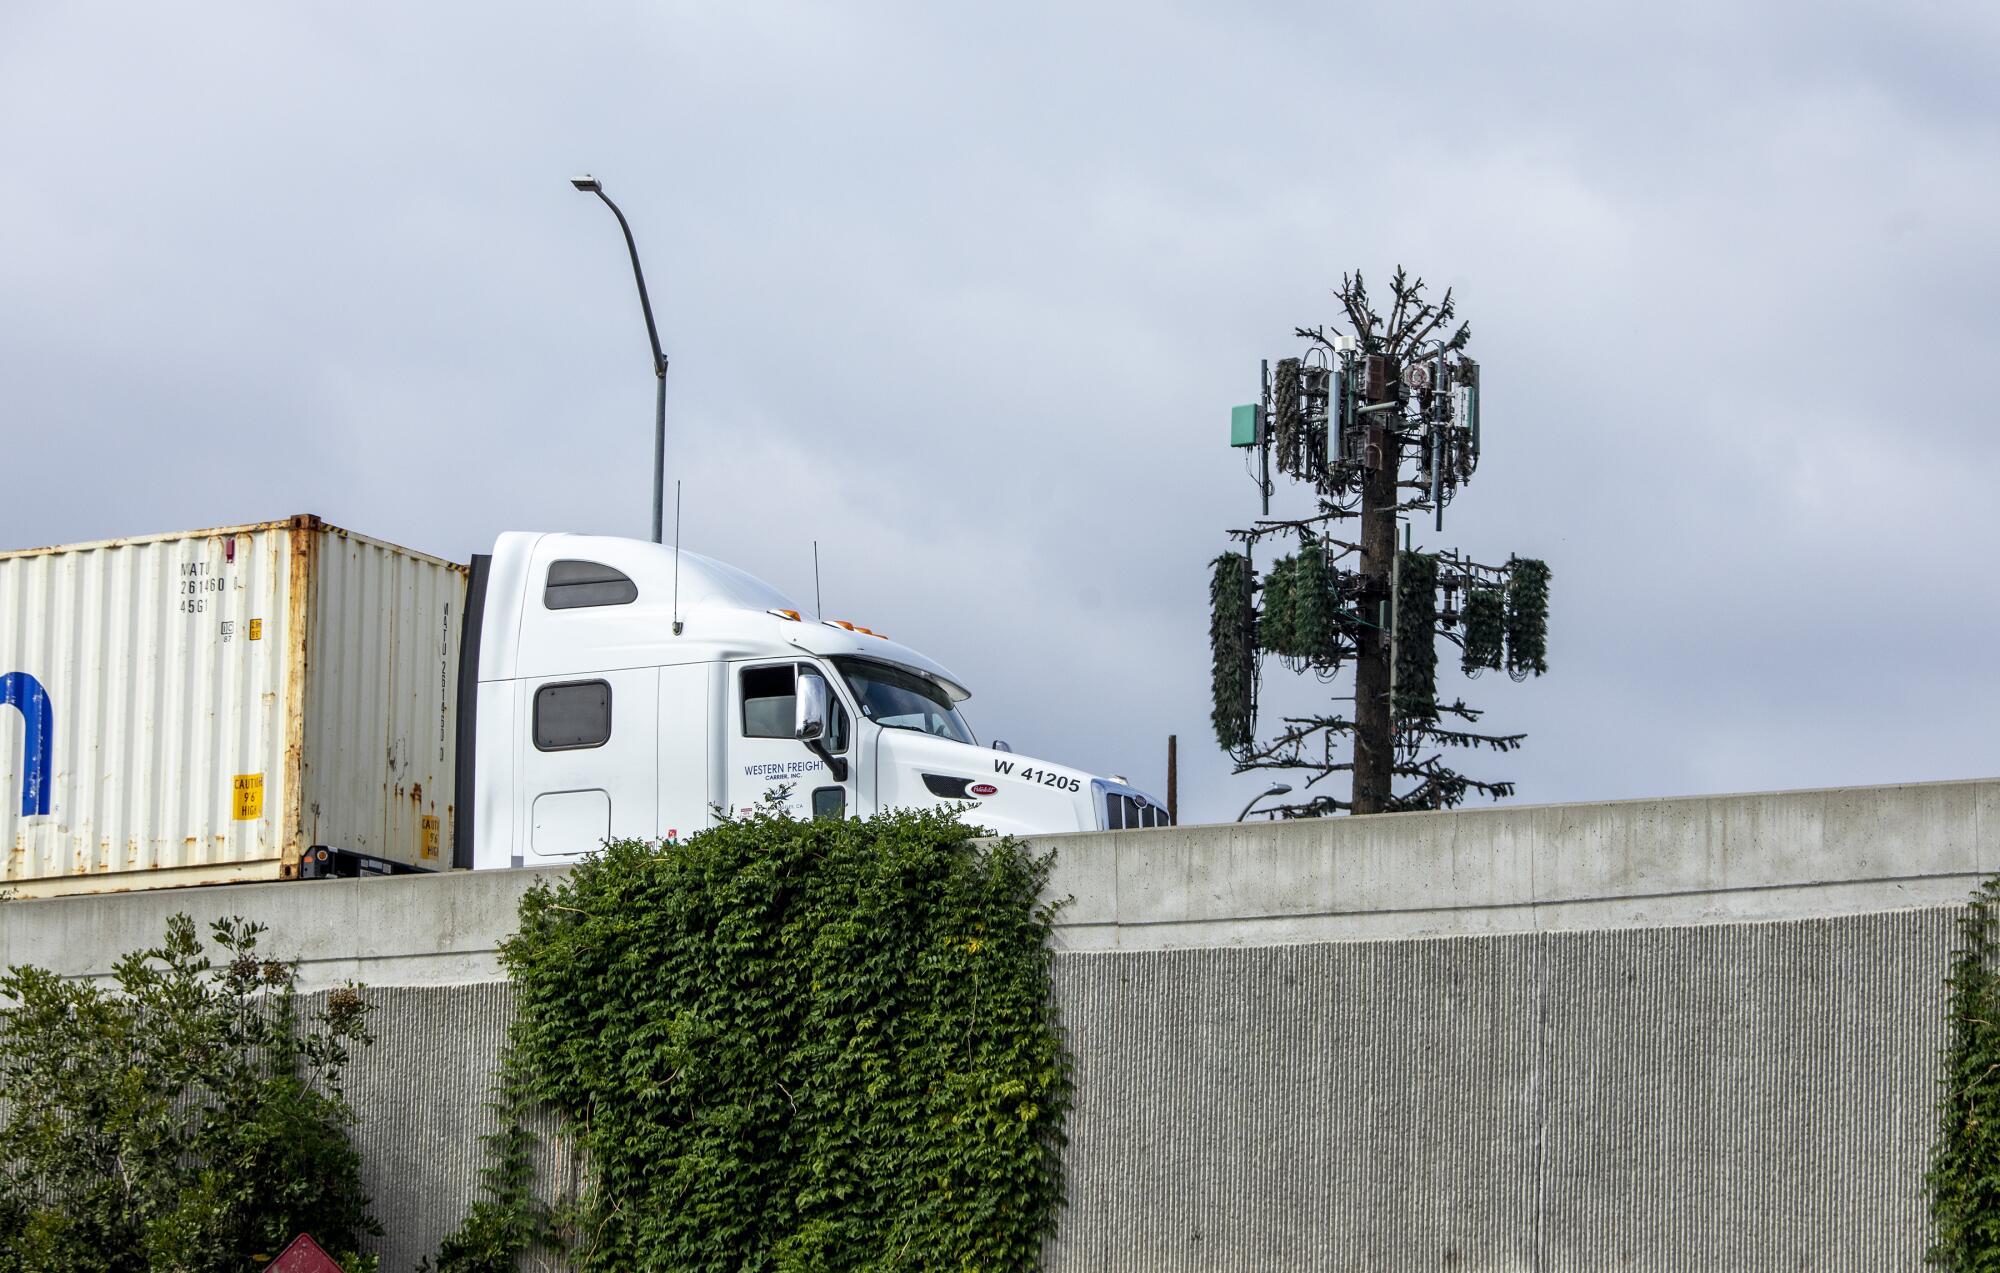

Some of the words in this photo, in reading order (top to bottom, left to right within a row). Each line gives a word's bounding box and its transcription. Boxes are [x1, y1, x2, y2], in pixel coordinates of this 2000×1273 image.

[745, 763, 784, 776] WESTERN
[787, 760, 824, 772] FREIGHT
[994, 759, 1014, 774] W
[1021, 768, 1081, 792] 41205
[765, 773, 789, 781] CARRIER,
